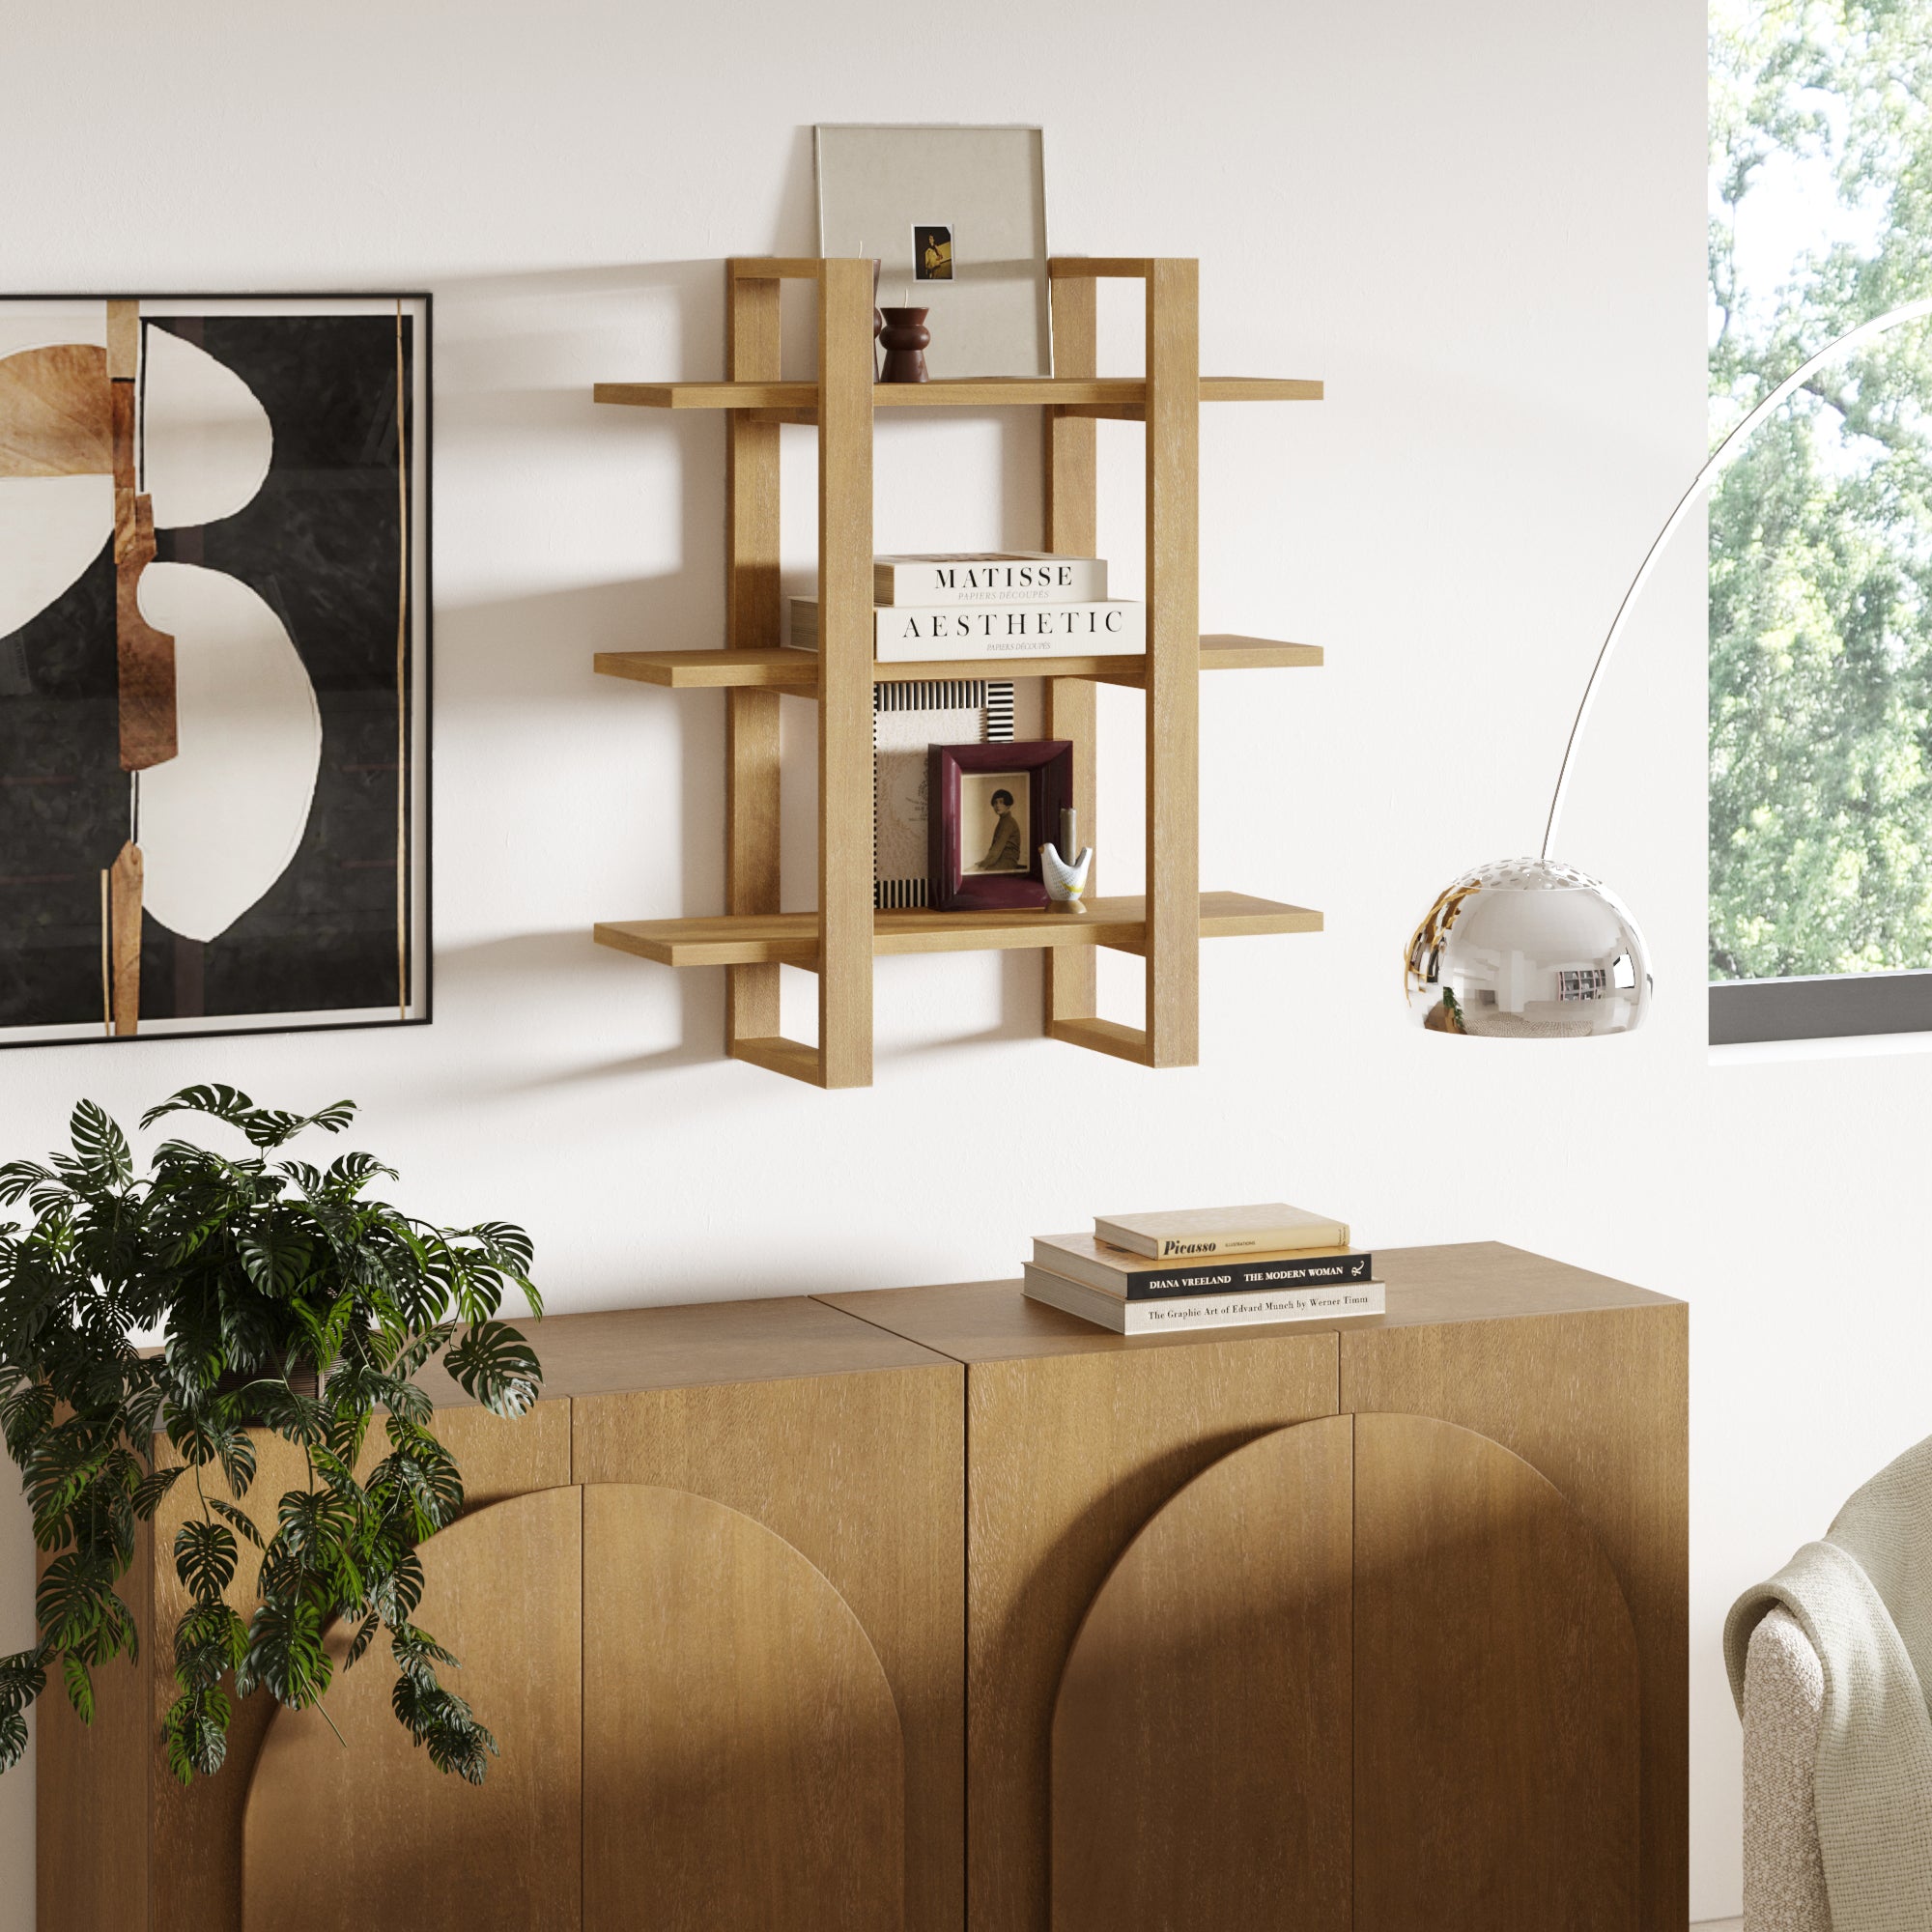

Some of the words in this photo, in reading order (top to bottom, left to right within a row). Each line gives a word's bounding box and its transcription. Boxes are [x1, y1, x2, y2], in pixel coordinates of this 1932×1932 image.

[935, 566, 1072, 589] MATISSE
[958, 591, 997, 600] PAPIERS
[903, 611, 1122, 639] AESTHETIC
[1164, 1240, 1216, 1256] Picasso
[1244, 1272, 1264, 1282] THE
[1264, 1268, 1307, 1281] MODERN
[1307, 1265, 1344, 1277] WOMAN
[1150, 1280, 1179, 1290] DIANA
[1181, 1275, 1232, 1287] VREELAND
[1148, 1310, 1165, 1320] The
[1167, 1308, 1202, 1320] Graphic
[1204, 1307, 1219, 1316] Art
[1220, 1305, 1231, 1315] of
[1232, 1303, 1264, 1314] Edvard
[1265, 1300, 1294, 1311] Munch
[1296, 1299, 1306, 1310] by
[1309, 1297, 1341, 1307] Werner
[1344, 1294, 1368, 1304] Timm
